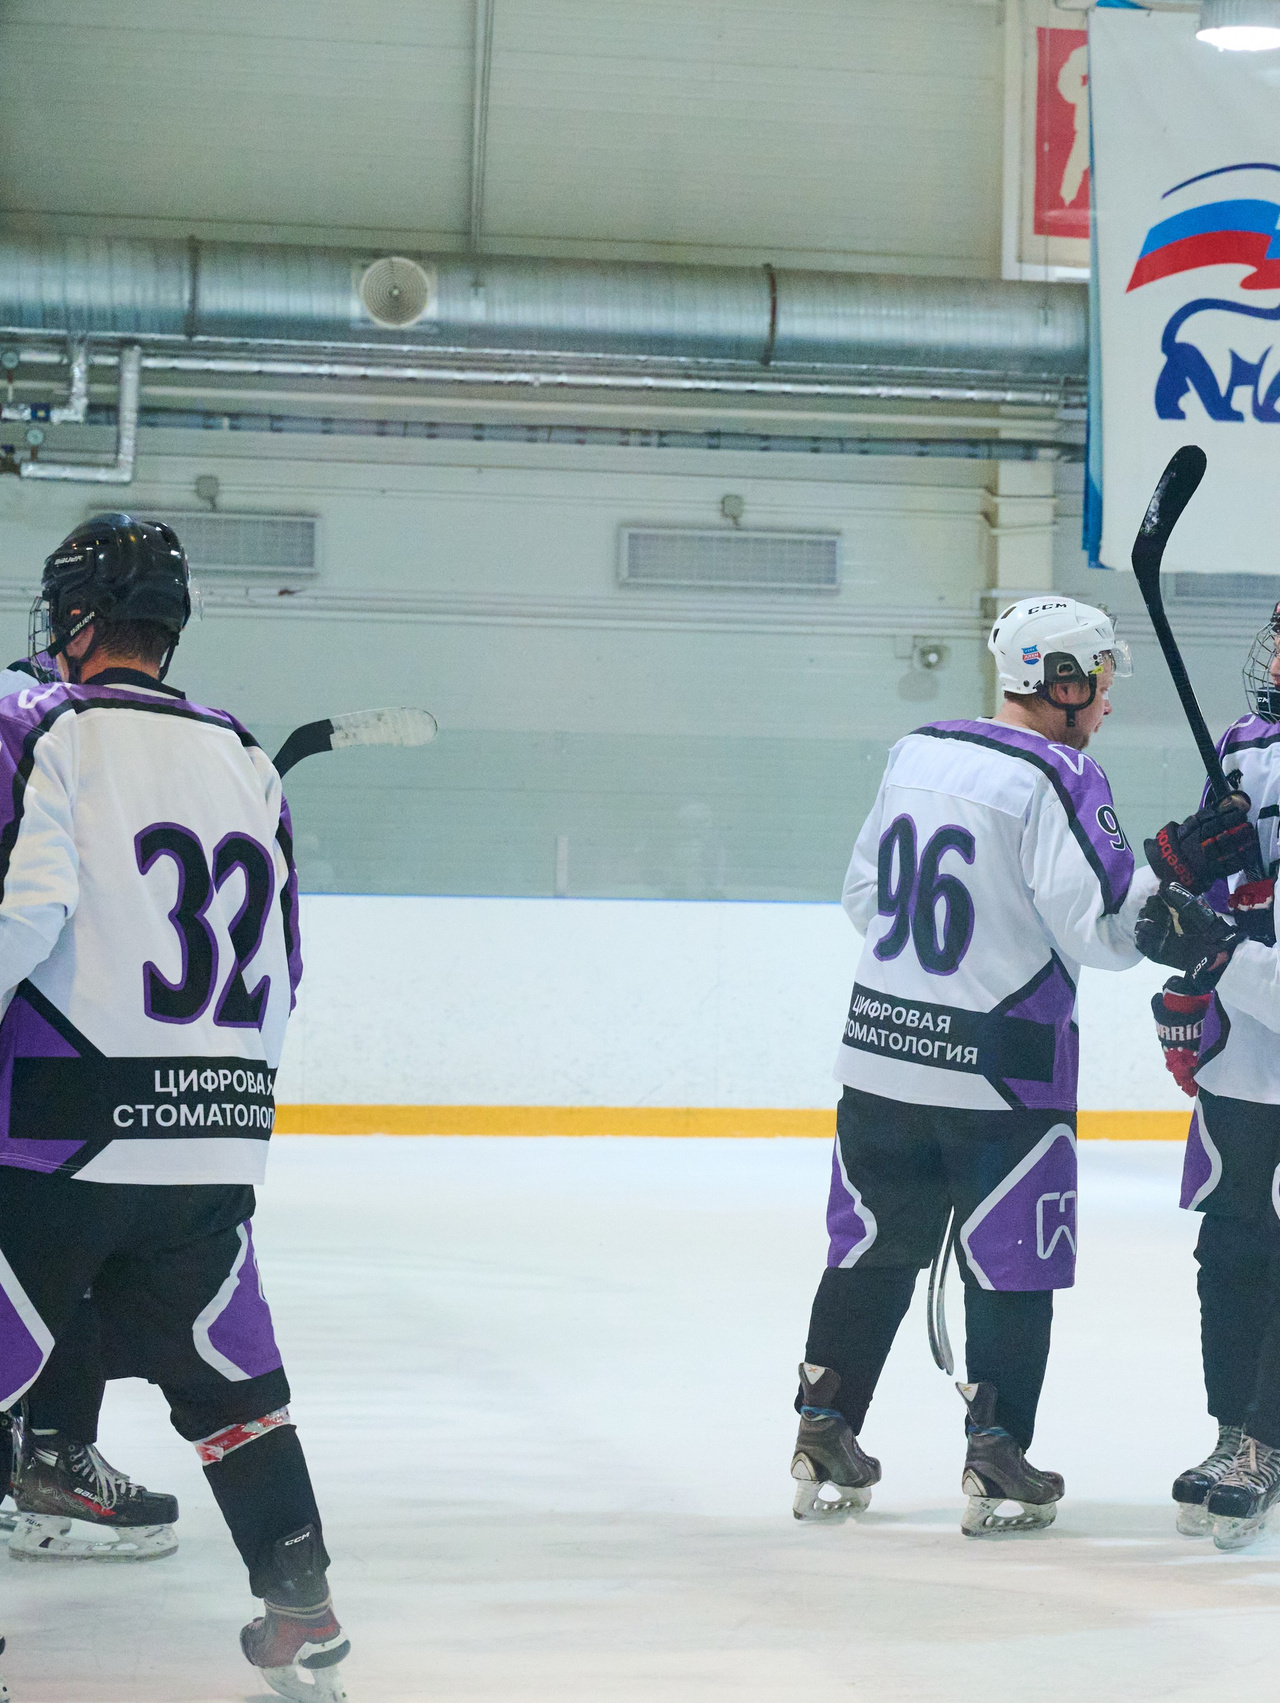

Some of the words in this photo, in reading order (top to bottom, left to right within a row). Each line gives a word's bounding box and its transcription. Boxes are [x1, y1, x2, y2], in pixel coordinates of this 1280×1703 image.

[1027, 603, 1067, 615] CCM
[872, 813, 976, 976] 96
[133, 822, 276, 1028] 32
[852, 994, 952, 1034] ЦИФРОВАЯ
[154, 1068, 274, 1098] ЦИФРОВАЯ
[112, 1103, 275, 1129] СТОМАТОЛОГ
[284, 1531, 310, 1546] CCM
